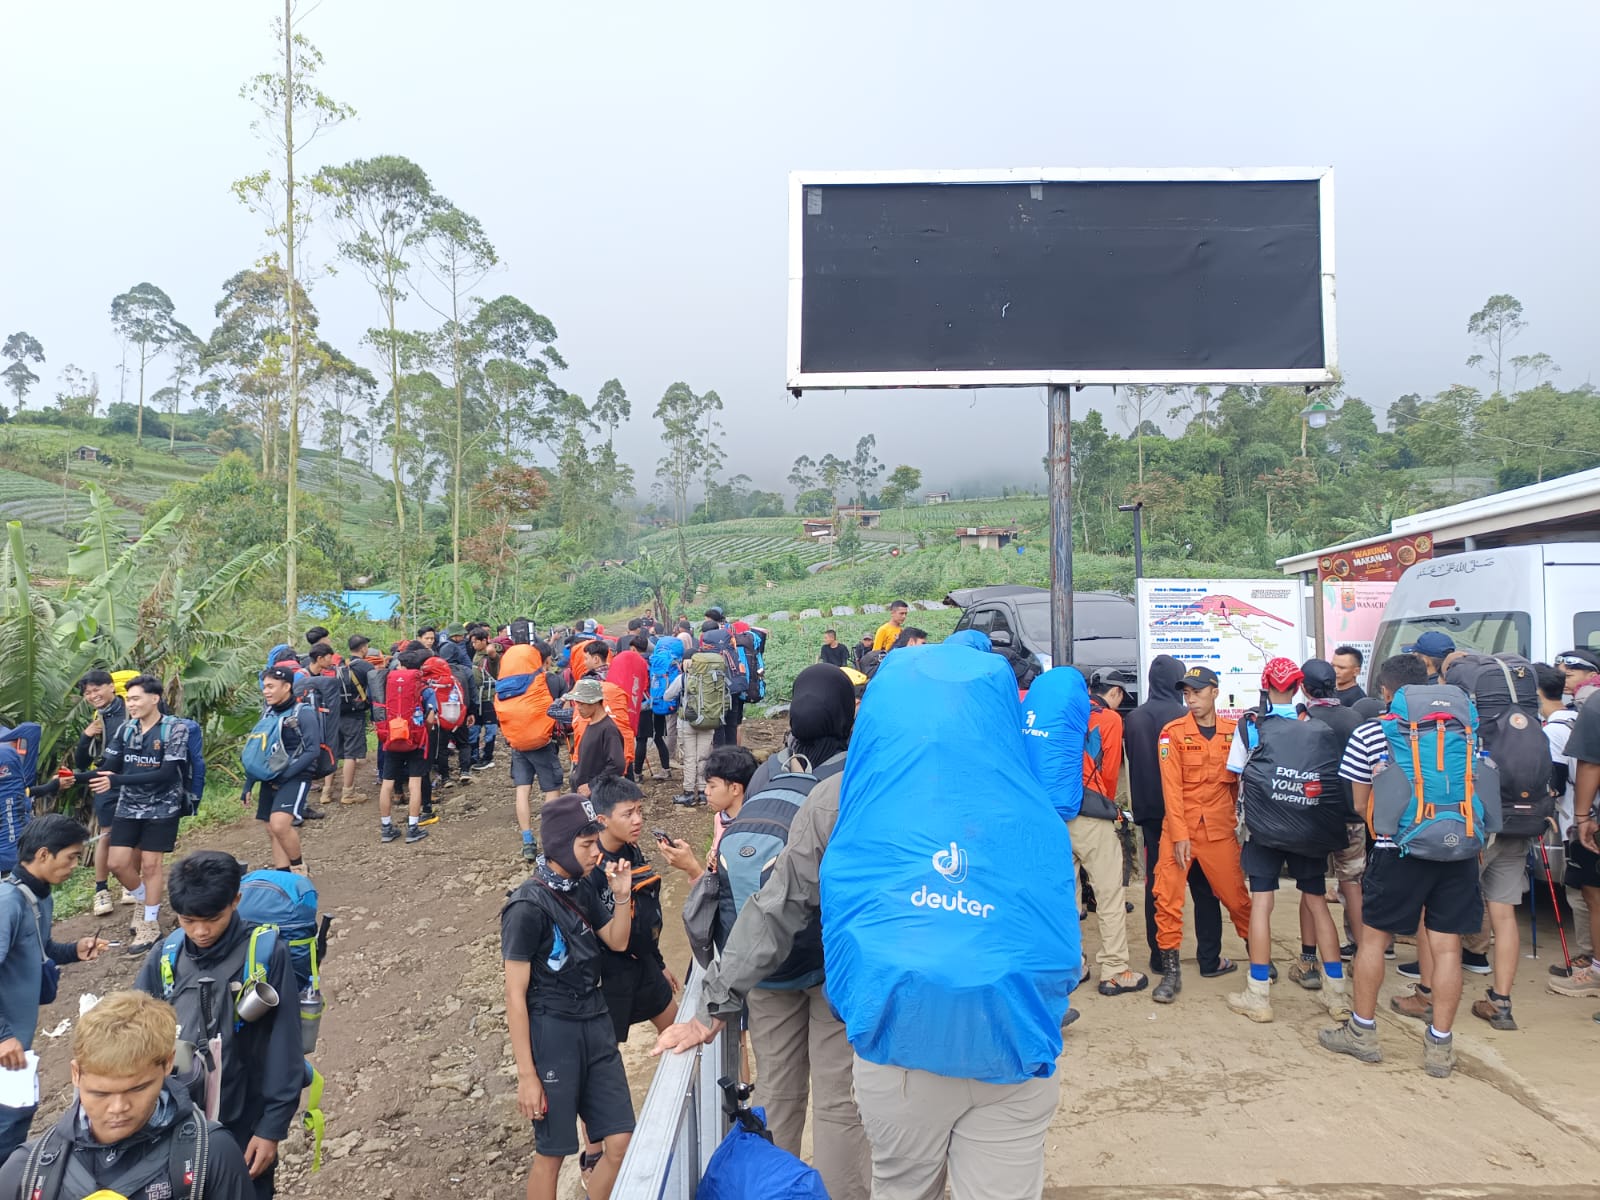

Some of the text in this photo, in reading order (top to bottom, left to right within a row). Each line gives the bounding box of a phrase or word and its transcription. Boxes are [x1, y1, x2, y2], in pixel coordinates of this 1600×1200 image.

[1276, 767, 1320, 781] EXPLORE
[1271, 778, 1304, 794] YOUR
[910, 884, 995, 919] deuter
